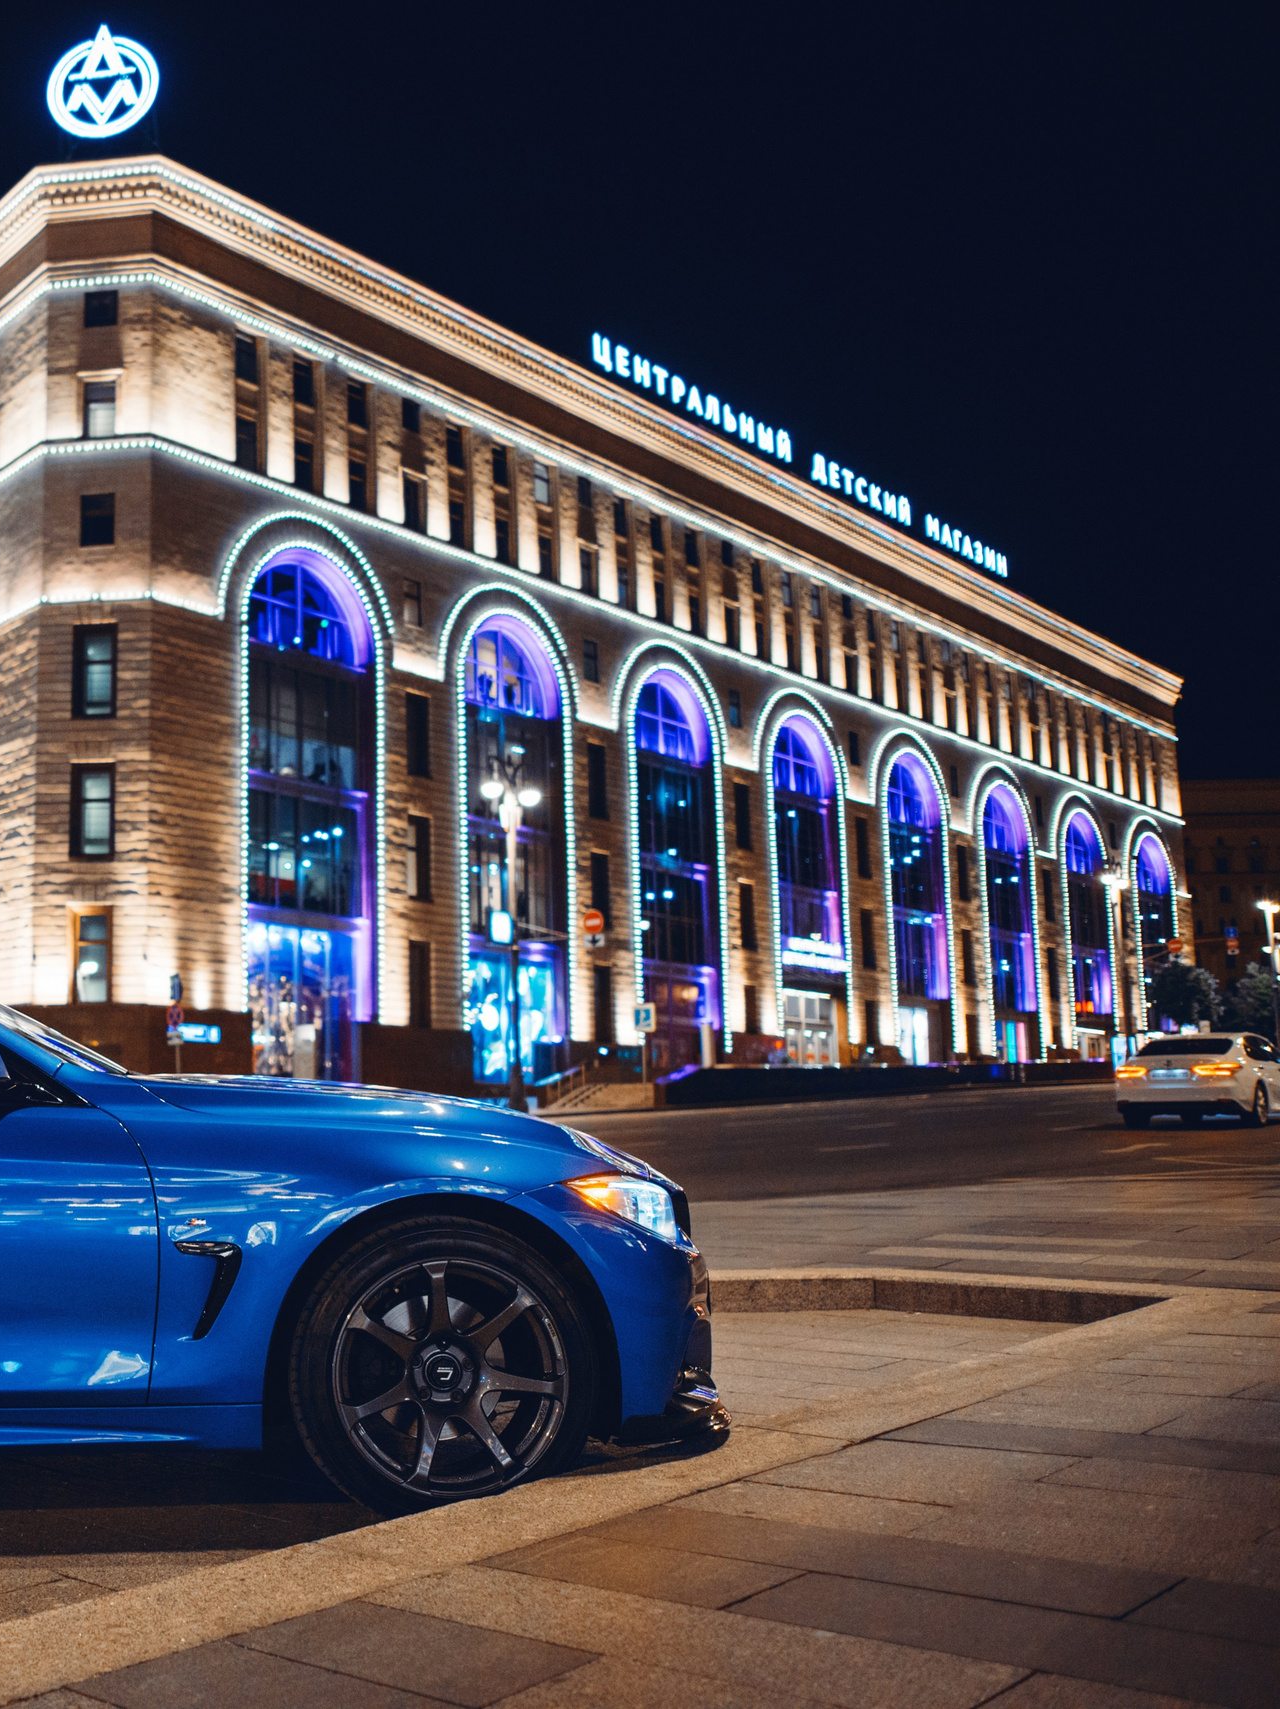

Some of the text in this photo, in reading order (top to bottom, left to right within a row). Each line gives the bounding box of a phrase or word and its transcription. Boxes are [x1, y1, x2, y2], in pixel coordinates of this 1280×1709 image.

[592, 332, 1009, 578] ЦЕНТРАЛЬНЫЙ ДЕТСКИЙ МАГАЗИН
